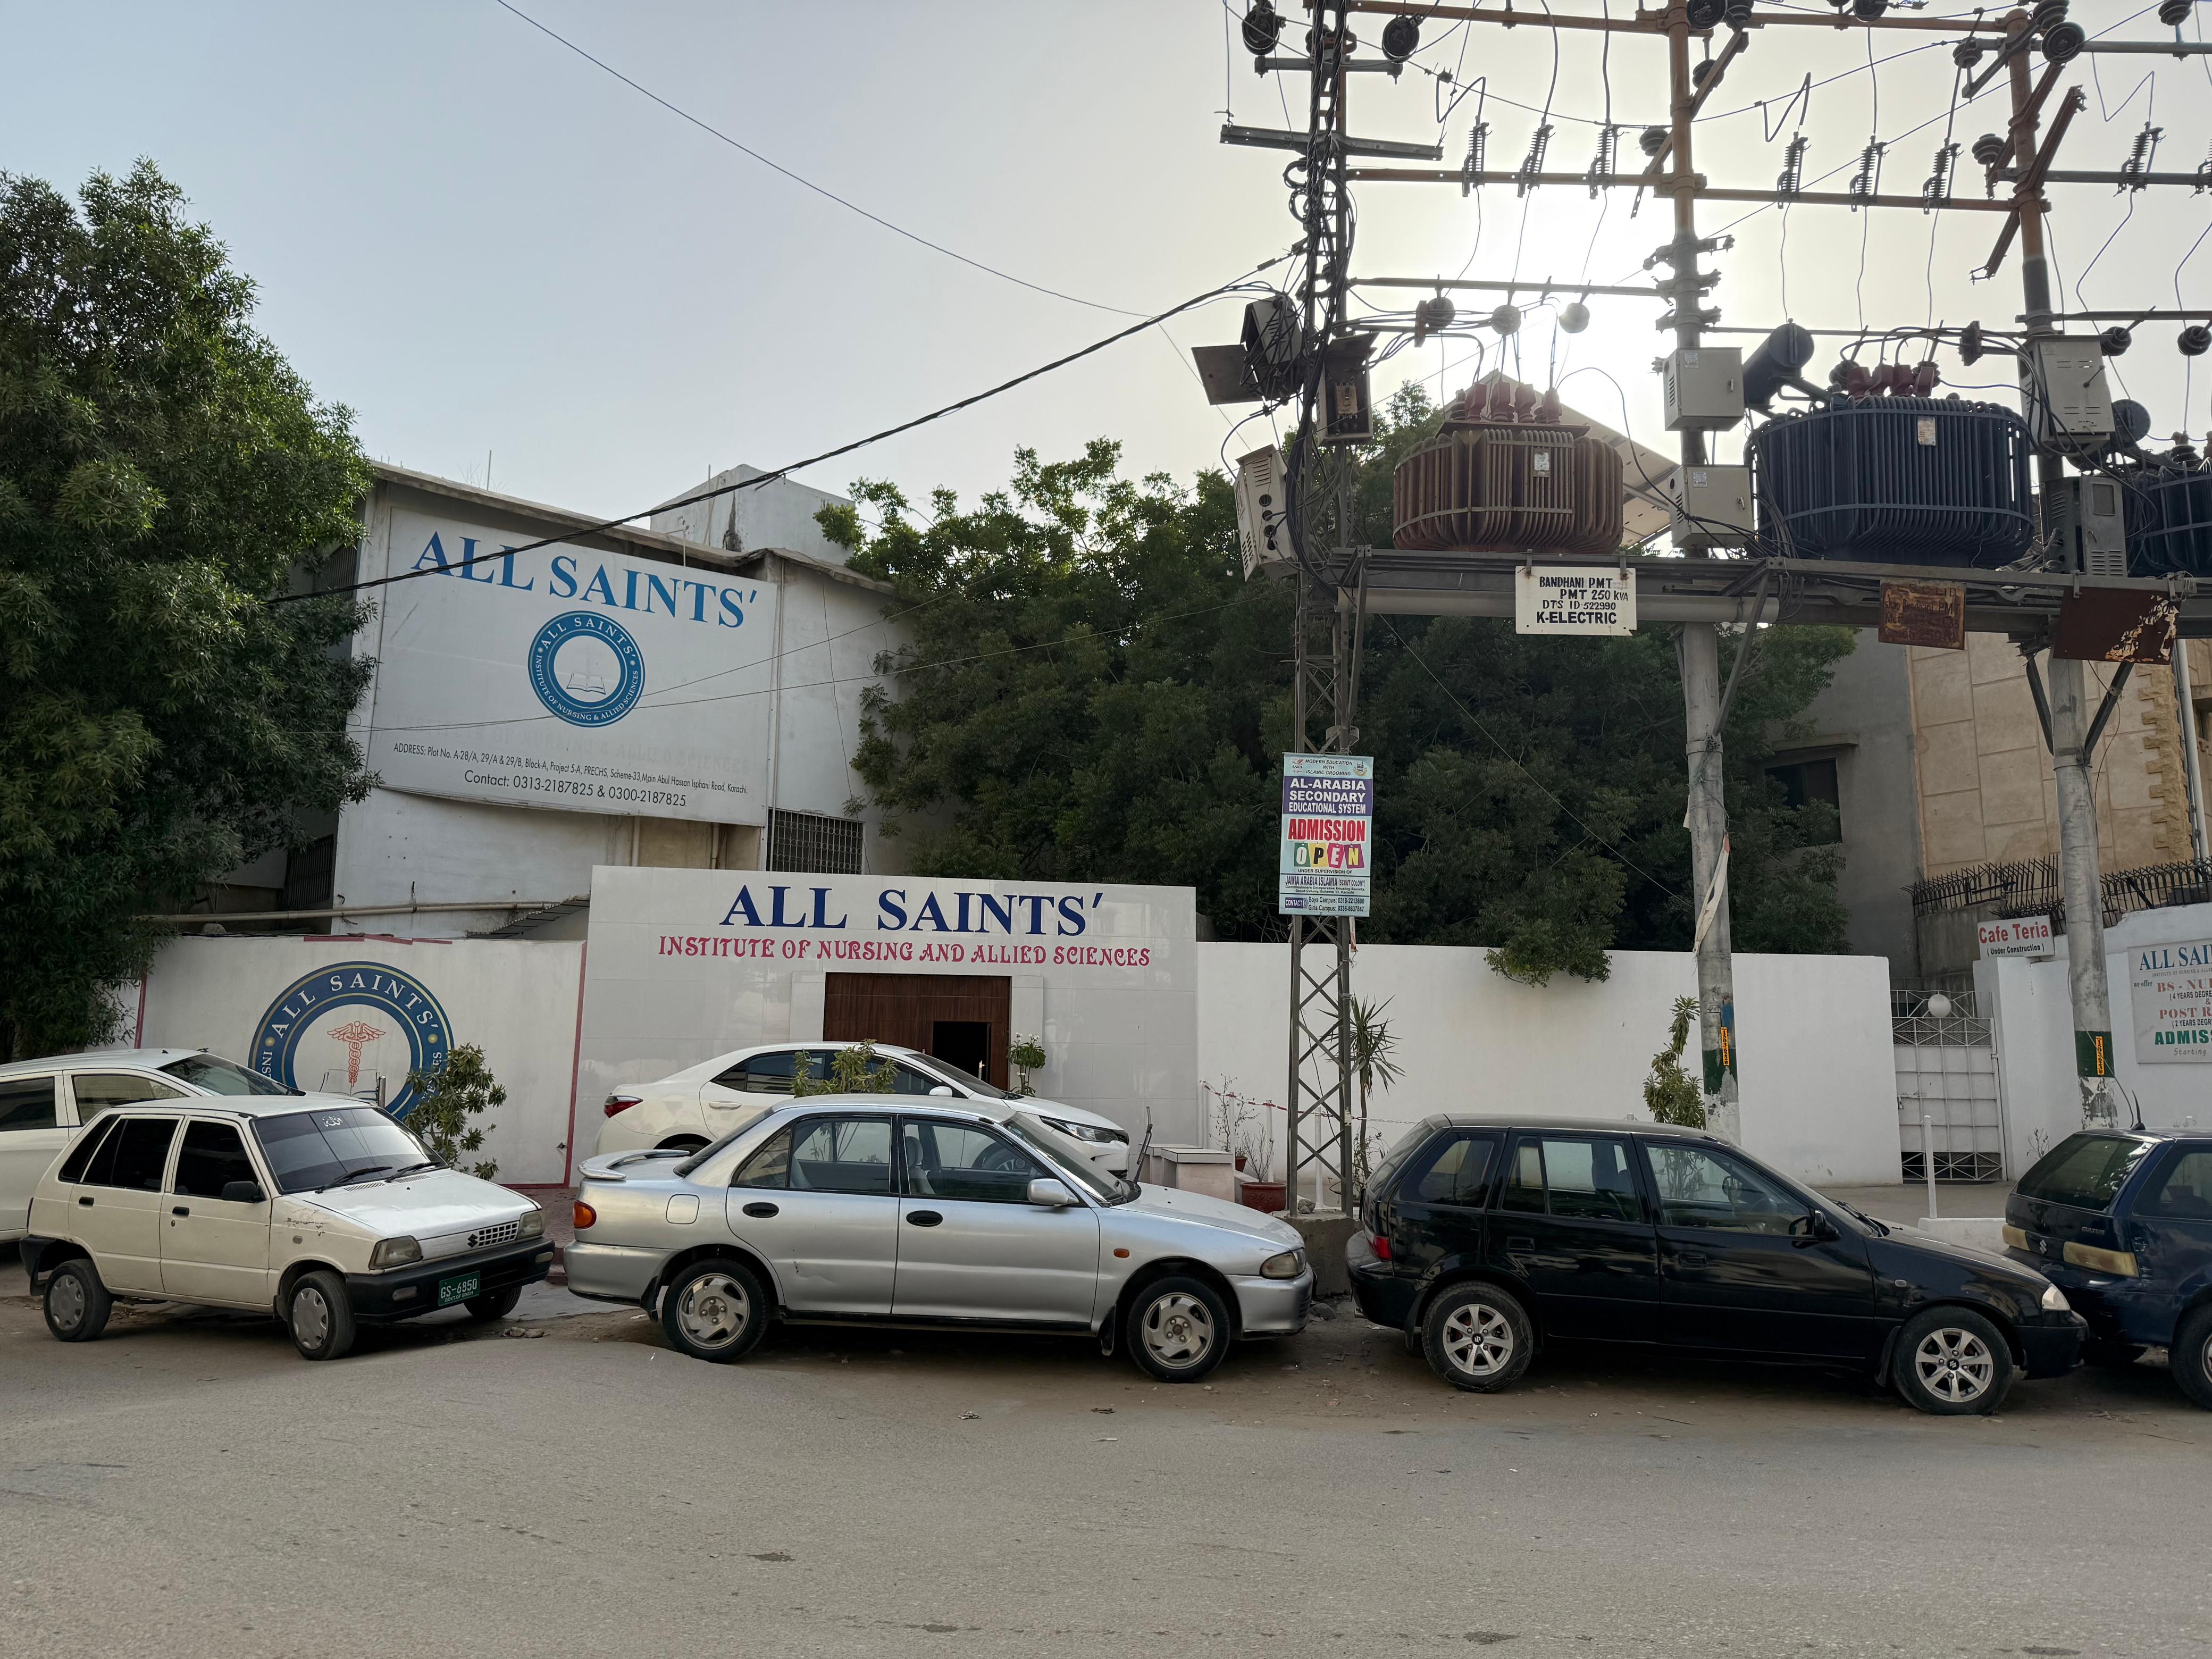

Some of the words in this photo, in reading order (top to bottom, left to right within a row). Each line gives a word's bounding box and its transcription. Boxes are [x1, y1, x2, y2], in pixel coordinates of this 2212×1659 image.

[411, 531, 534, 591] ALL
[549, 556, 757, 628] SAINTS'
[1539, 576, 1584, 588] BANDHANI
[1589, 577, 1613, 589] PMT
[1560, 589, 1587, 600] PMT
[1591, 590, 1611, 600] 250
[1543, 600, 1563, 609] DTS
[1583, 602, 1616, 610] 522990
[1537, 611, 1617, 624] K-ELECTRIC
[541, 623, 566, 649] ALL
[574, 617, 636, 657] SAINTS'
[536, 655, 550, 696] INSTITUTE
[548, 696, 558, 705] OF
[557, 703, 591, 720] NURSING
[601, 703, 624, 719] ALLIED
[624, 671, 638, 704] SCIENCES
[393, 743, 426, 756] ADDRESS:
[428, 747, 439, 757] Plot
[440, 748, 451, 759] No.
[453, 750, 479, 763] A-28/A,
[481, 753, 497, 765] 29/A
[506, 756, 523, 768] 29/B,
[525, 758, 548, 771] Block-A,
[550, 762, 569, 774] Project
[571, 764, 582, 775] 5-A,
[584, 765, 608, 778] PRECHS,
[657, 775, 670, 784] Abul
[671, 776, 690, 787] Hassan
[692, 779, 710, 790] Isphani
[711, 781, 726, 792] Road,
[727, 783, 748, 794] Karachi.
[465, 770, 509, 786] Contact:
[514, 775, 593, 796] 0313-2187825
[597, 785, 605, 798] &
[1290, 778, 1366, 791] AL-ARABIA
[1289, 791, 1366, 803] SECONDARY
[1289, 802, 1337, 814] EDUCATIONAL
[1338, 803, 1366, 814] SYSTEM
[1288, 818, 1365, 842] ADMISSION
[1296, 847, 1359, 865] OPEN
[1285, 876, 1300, 885] JAMIA
[1300, 876, 1318, 886] ARABIA
[1319, 877, 1337, 886] ISLAMIA
[719, 884, 848, 928] ALL
[877, 889, 1104, 936] SAINTS'
[1979, 926, 2008, 944] Cafe
[2012, 921, 2049, 940] Teria
[658, 935, 775, 958] INSTITUTE
[782, 939, 811, 959] OF
[817, 940, 914, 961] NURSING
[919, 942, 965, 963] AND
[974, 944, 1047, 964] ALLIED
[1053, 945, 1151, 967] SCIENCES
[2139, 949, 2175, 971] ALL
[2178, 944, 2212, 967] SAI
[2157, 981, 2175, 992] BS
[271, 990, 316, 1038] ALL
[330, 973, 439, 1028] SAINTS'
[2159, 1007, 2197, 1019] POST
[2155, 1029, 2212, 1045] ADMIS
[2174, 1047, 2207, 1057] Starting
[440, 1278, 477, 1299] GS-6850
